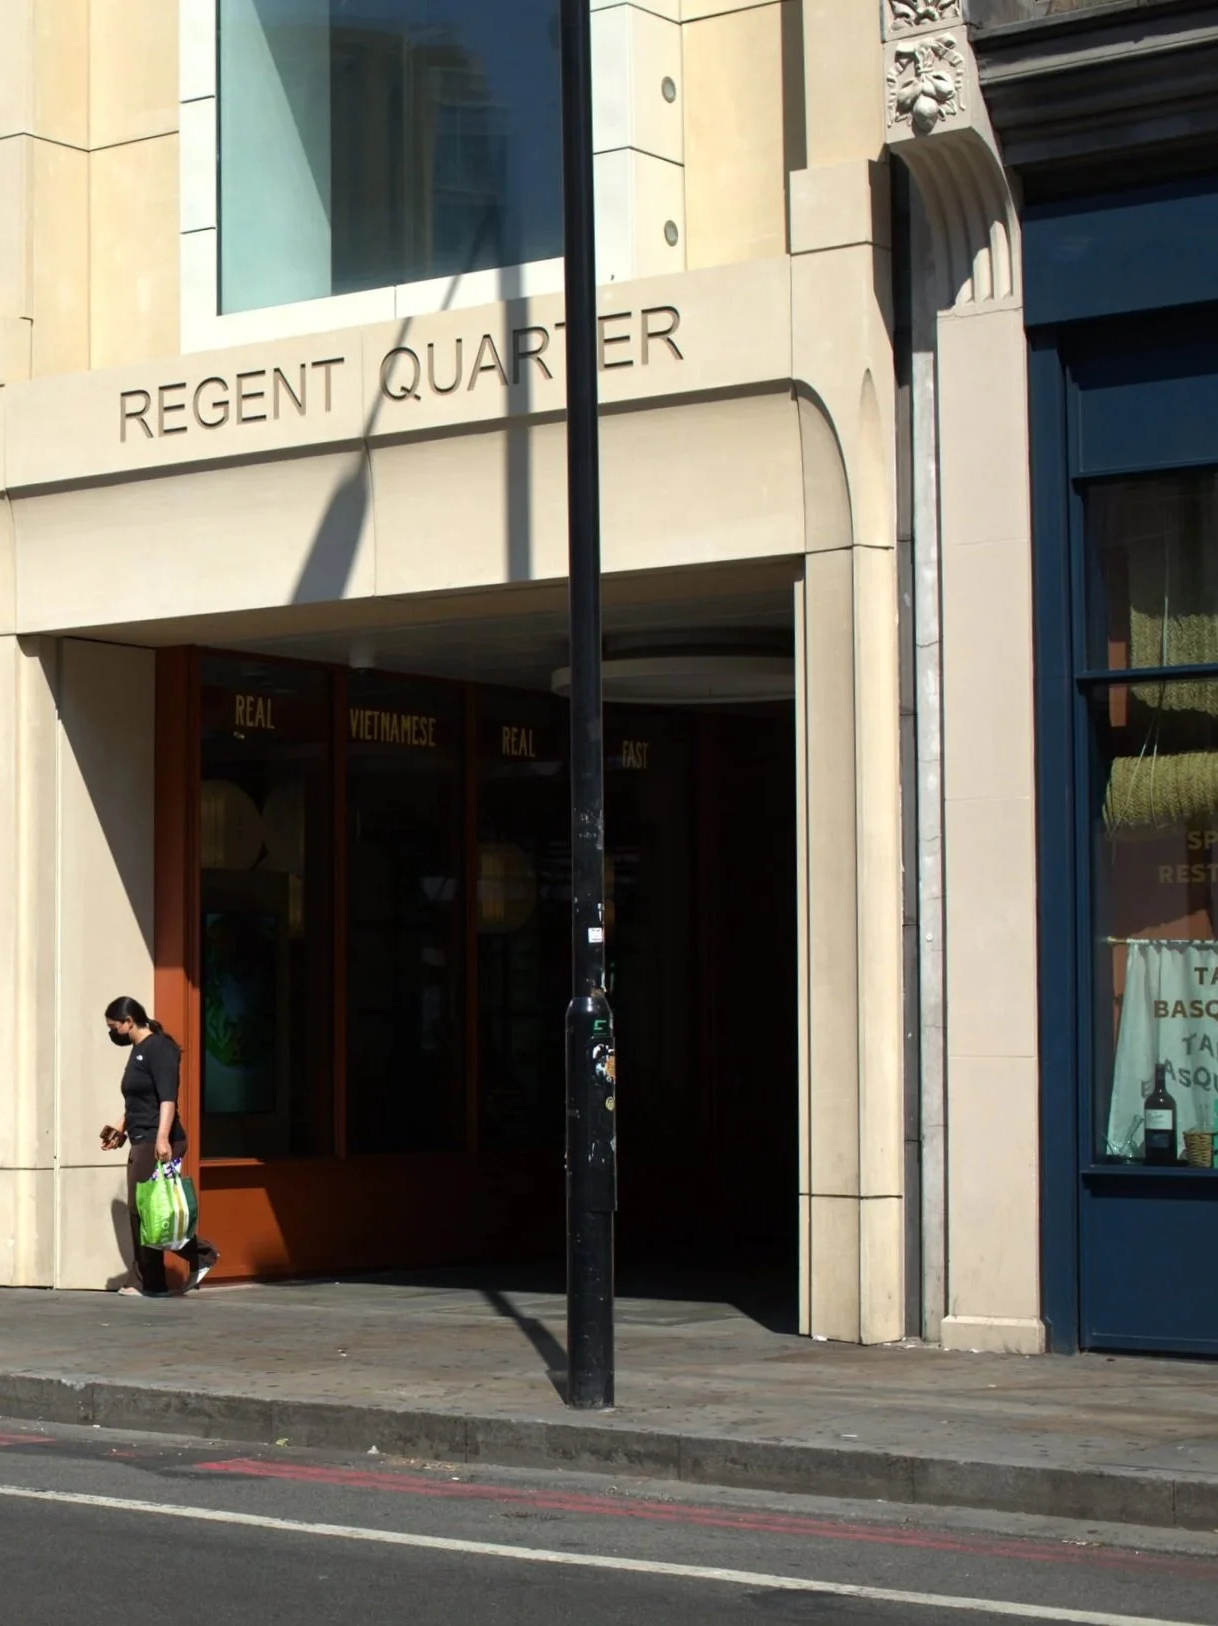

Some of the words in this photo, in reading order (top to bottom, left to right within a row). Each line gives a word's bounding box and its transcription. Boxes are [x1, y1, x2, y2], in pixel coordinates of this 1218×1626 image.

[120, 357, 344, 442] REGENT
[380, 305, 684, 401] QUARER
[235, 694, 275, 729] REAL
[349, 708, 436, 747] VIETNAMESE
[502, 726, 536, 758] REAL
[622, 739, 649, 770] FAST
